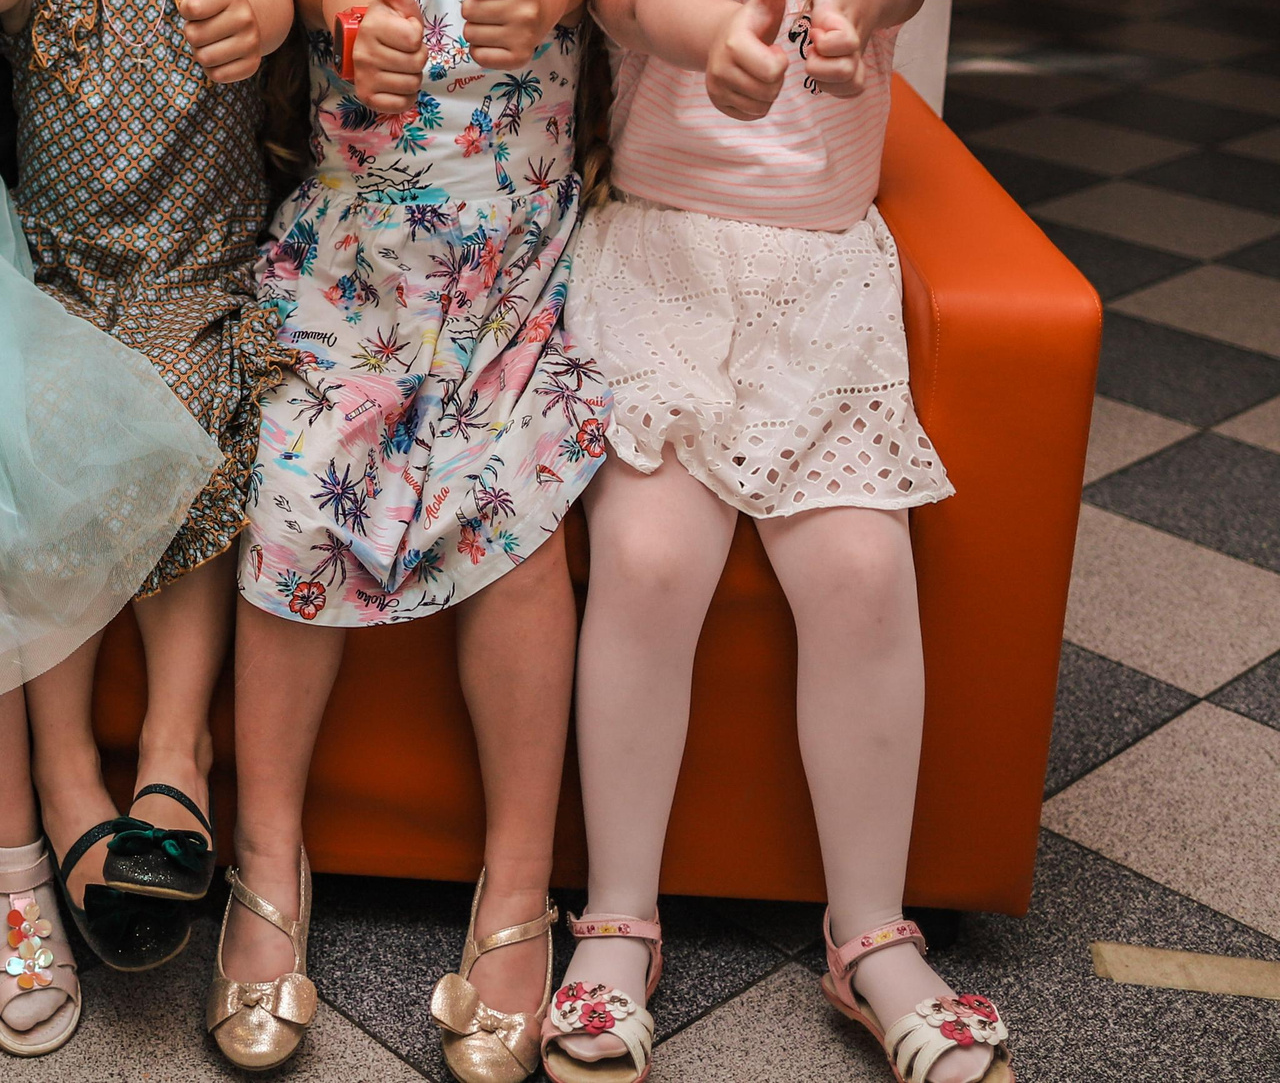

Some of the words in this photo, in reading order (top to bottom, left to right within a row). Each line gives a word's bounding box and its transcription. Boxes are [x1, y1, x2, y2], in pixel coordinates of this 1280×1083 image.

[289, 330, 338, 348] Hawaii
[423, 485, 451, 531] Aloha
[355, 588, 400, 613] Aloha
